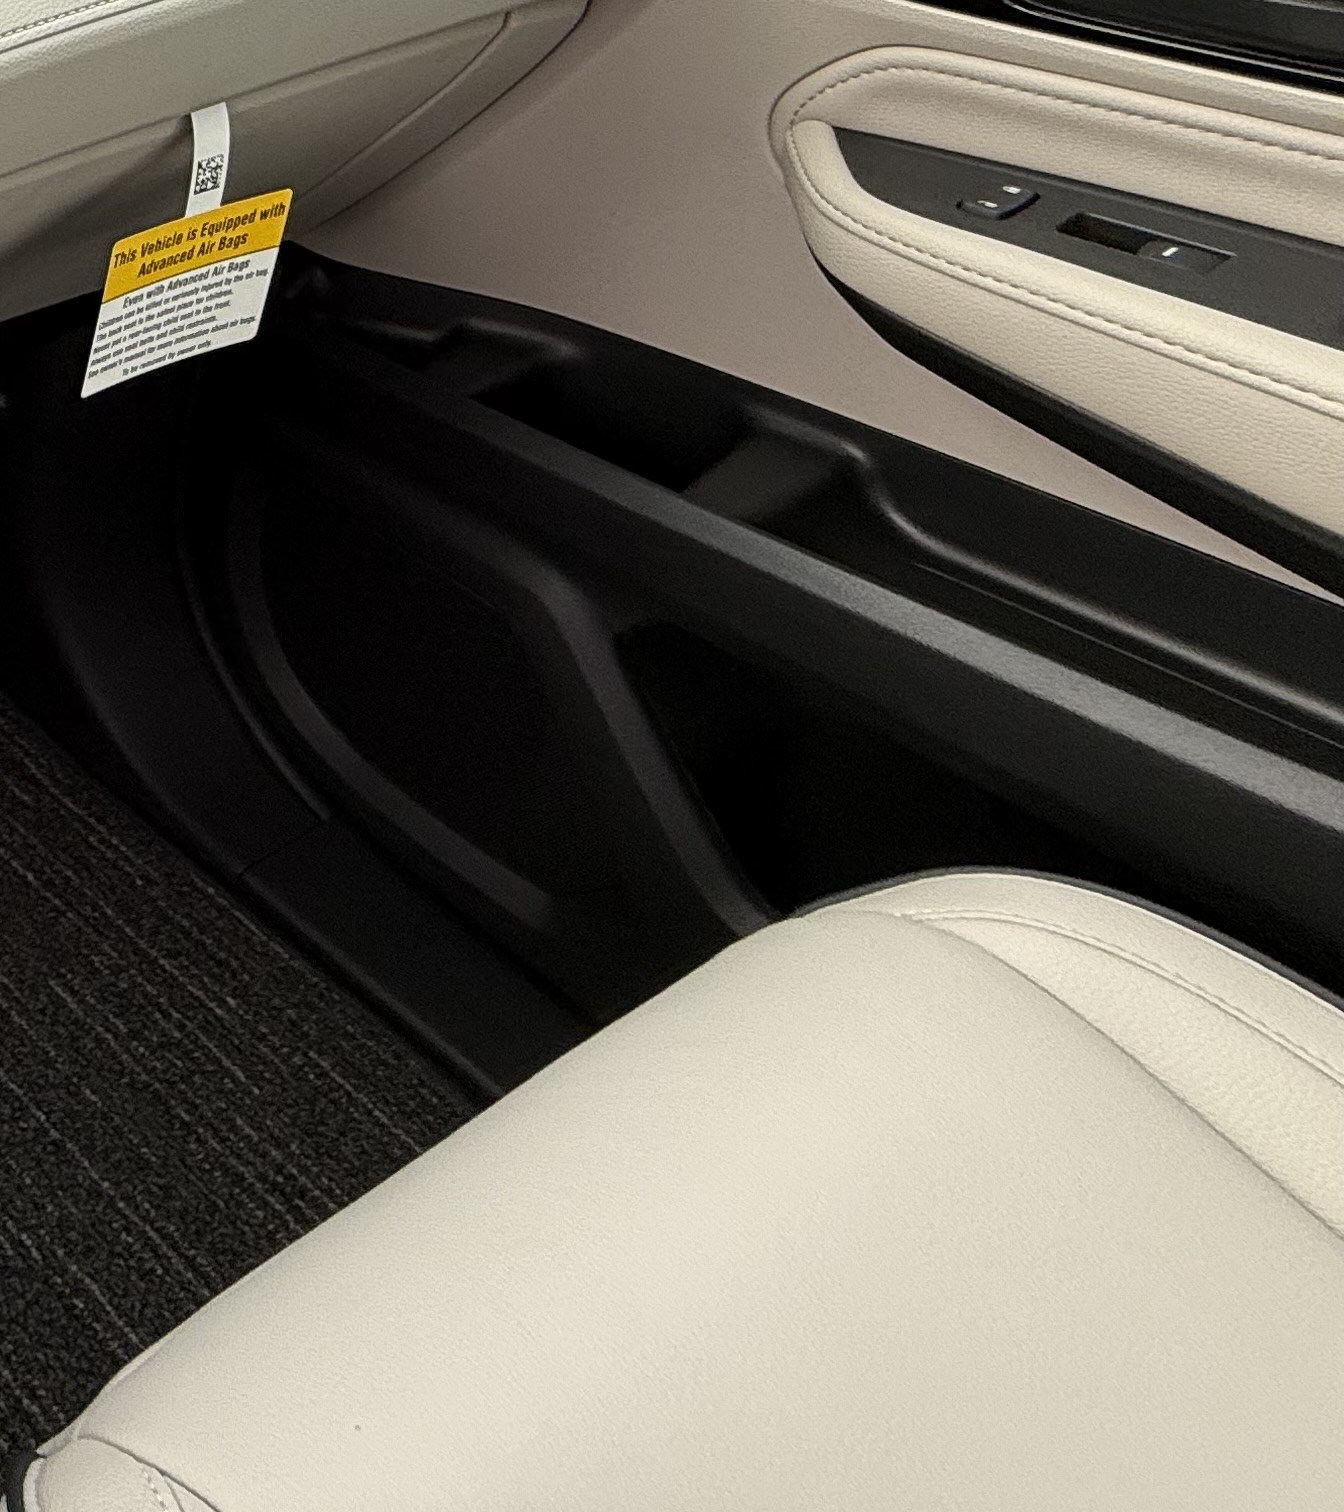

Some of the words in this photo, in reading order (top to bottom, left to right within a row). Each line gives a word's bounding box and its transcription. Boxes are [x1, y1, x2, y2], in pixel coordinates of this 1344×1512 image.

[114, 248, 138, 269] This
[140, 231, 184, 258] Vehicle
[186, 226, 199, 241] is
[200, 209, 257, 238] Equipped
[259, 201, 286, 221] with
[137, 244, 196, 278] Advanced
[197, 240, 216, 257] Air
[217, 232, 249, 251] Bags
[166, 268, 210, 292] Advanced
[211, 266, 227, 279] Air
[227, 259, 251, 273] Bags
